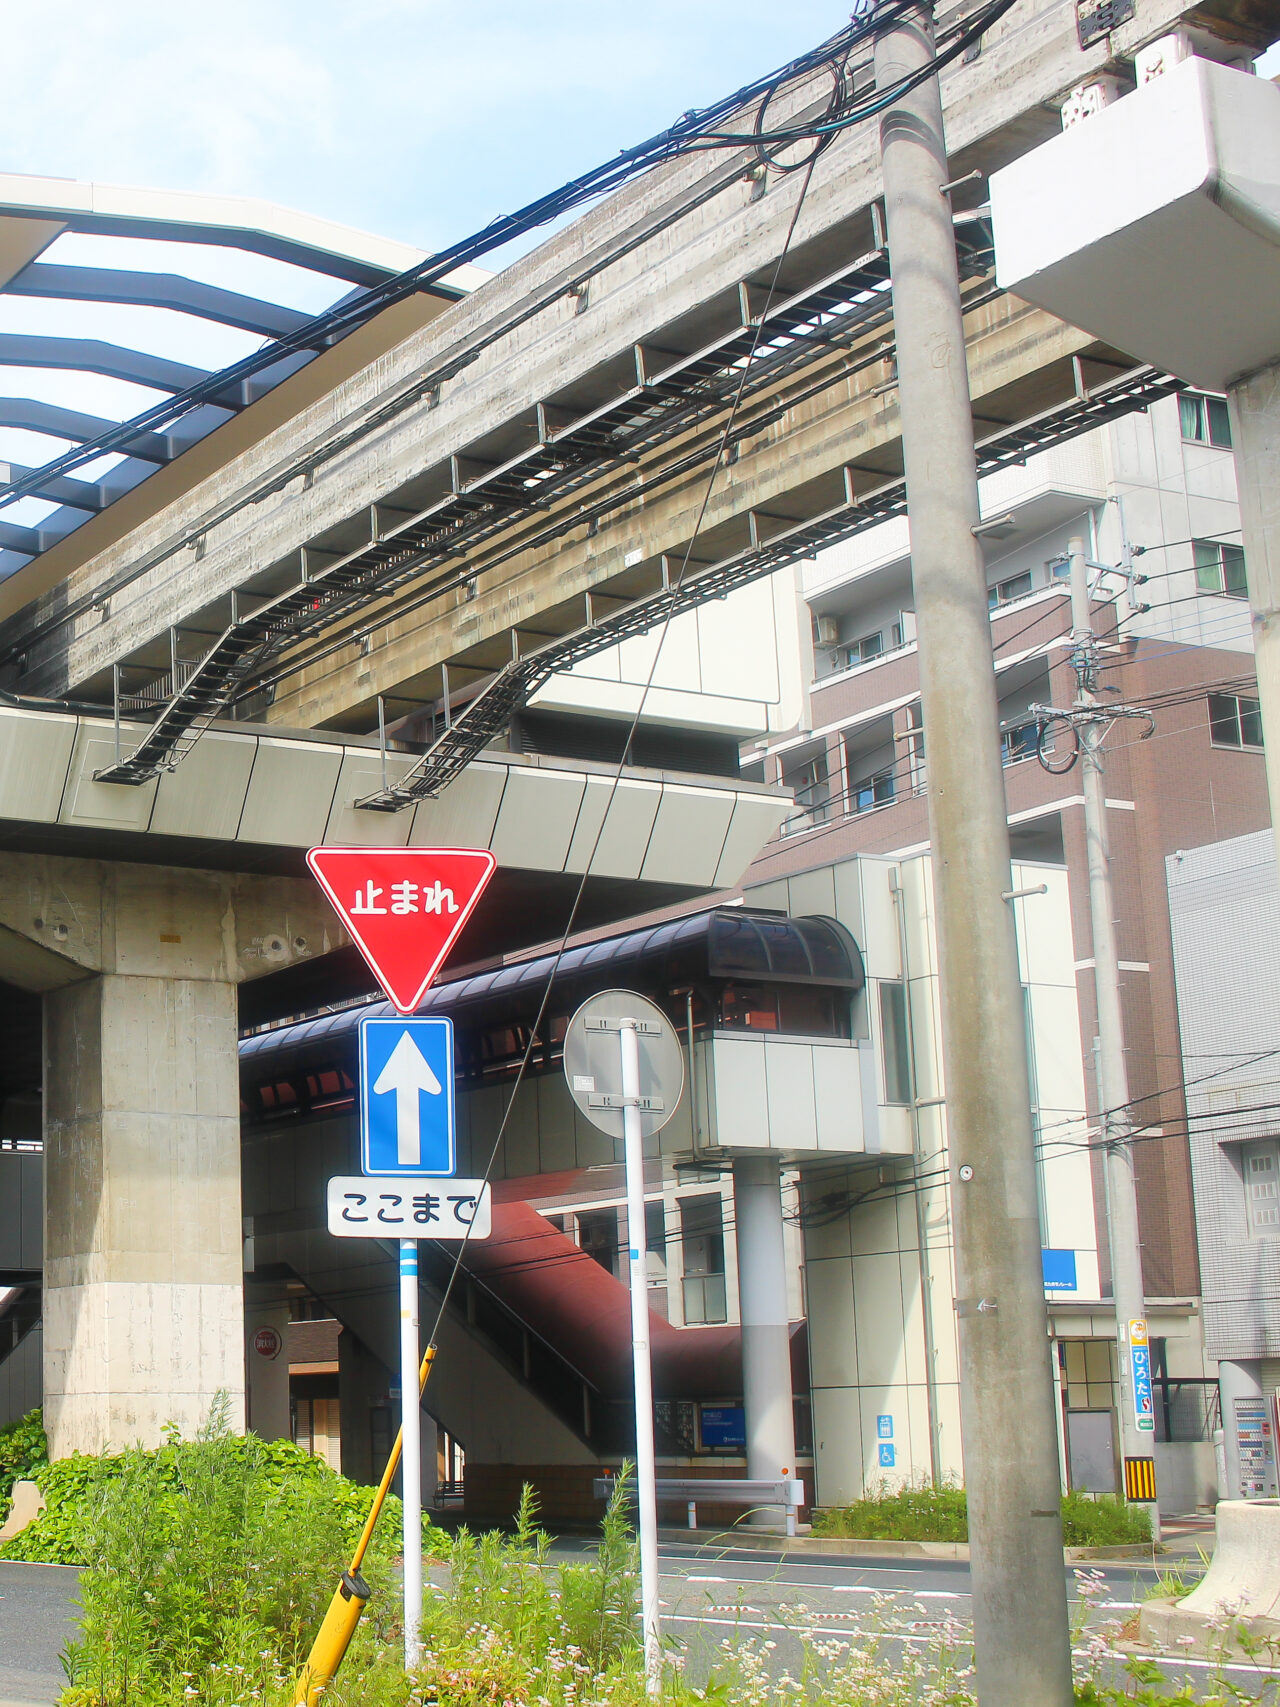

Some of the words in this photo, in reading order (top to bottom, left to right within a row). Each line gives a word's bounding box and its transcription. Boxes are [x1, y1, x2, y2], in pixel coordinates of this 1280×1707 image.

[349, 879, 460, 915] 止まれ
[342, 1193, 478, 1225] ここまで
[1133, 1351, 1149, 1396] ひろた
